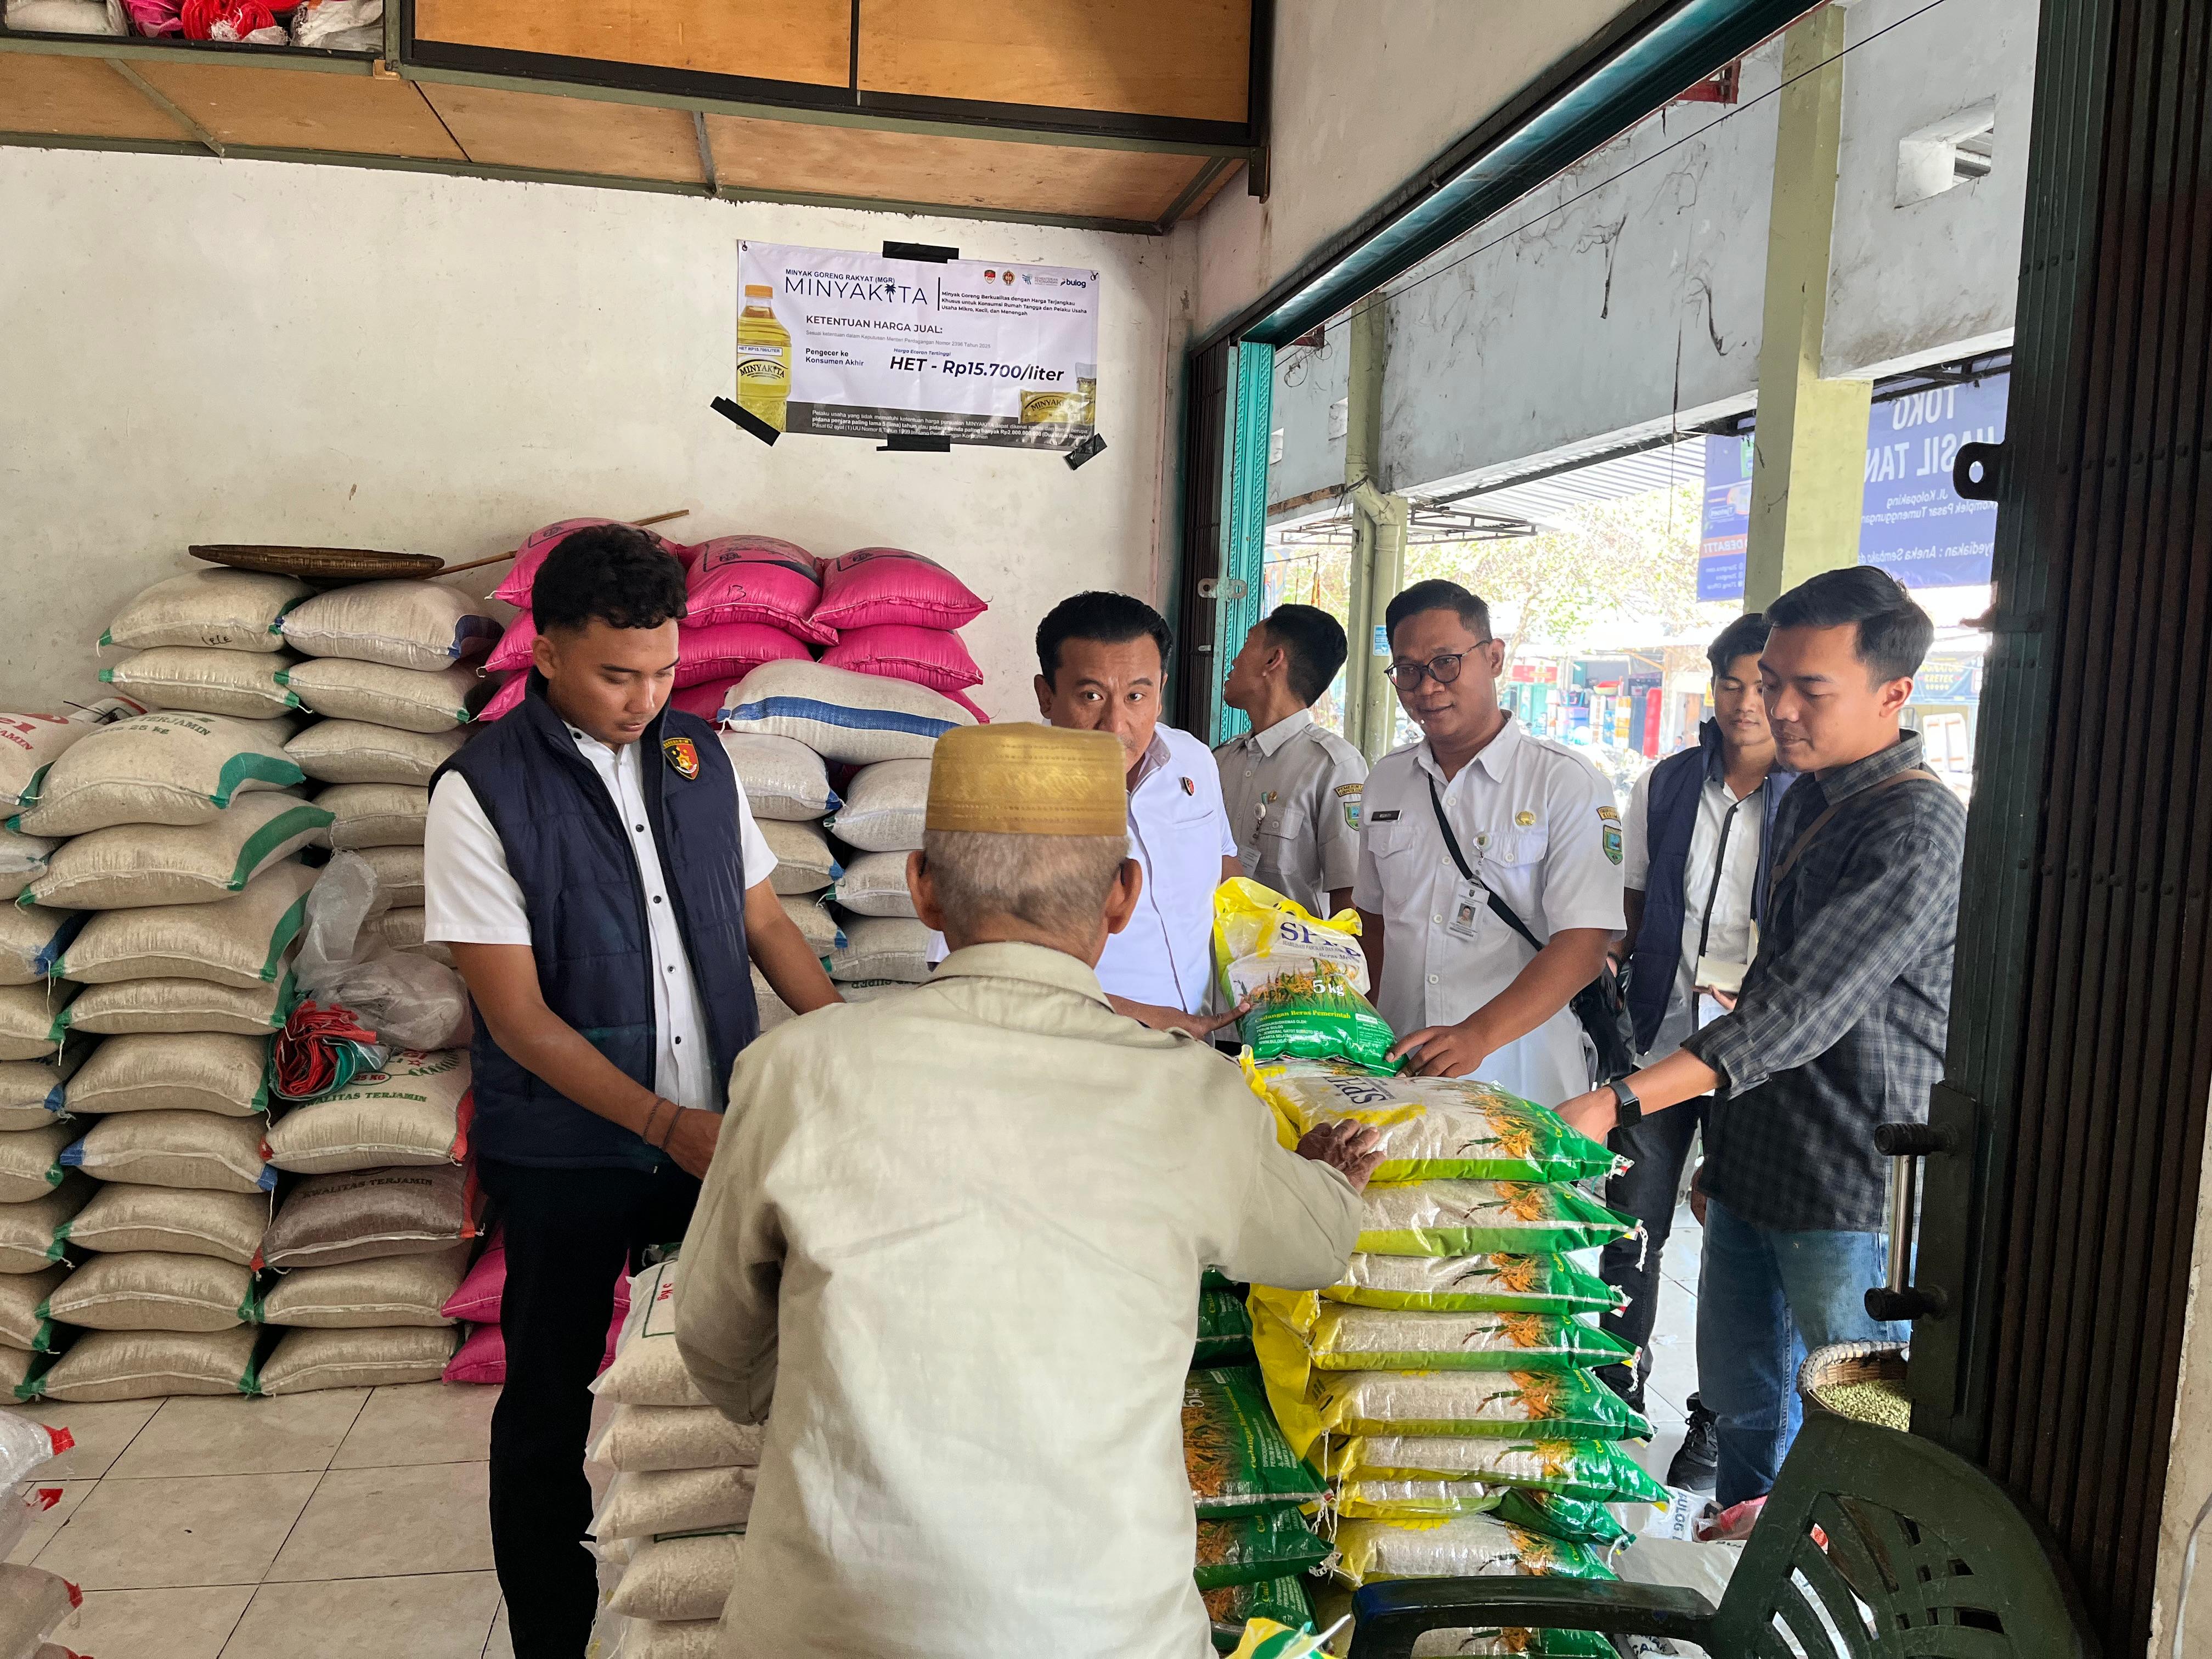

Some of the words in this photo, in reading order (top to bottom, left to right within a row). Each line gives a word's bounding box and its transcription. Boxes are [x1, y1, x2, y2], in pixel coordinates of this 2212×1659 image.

[786, 269, 812, 277] MINYAK
[814, 272, 843, 280] GORENG
[1066, 278, 1086, 289] bulog
[786, 276, 928, 304] MINYAKITA
[806, 315, 870, 328] KETENTUAN
[874, 320, 911, 331] HARGA
[914, 325, 943, 334] JUAL:
[806, 348, 839, 357] Pengecer
[806, 357, 843, 365] Konsumen
[890, 356, 928, 371] HET
[943, 360, 1064, 381] Rp15.700/liter
[1313, 980, 1325, 994] 5
[1328, 983, 1345, 997] kg
[1313, 1010, 1351, 1019] Pemerintah
[365, 1092, 427, 1102] TERJAMIN
